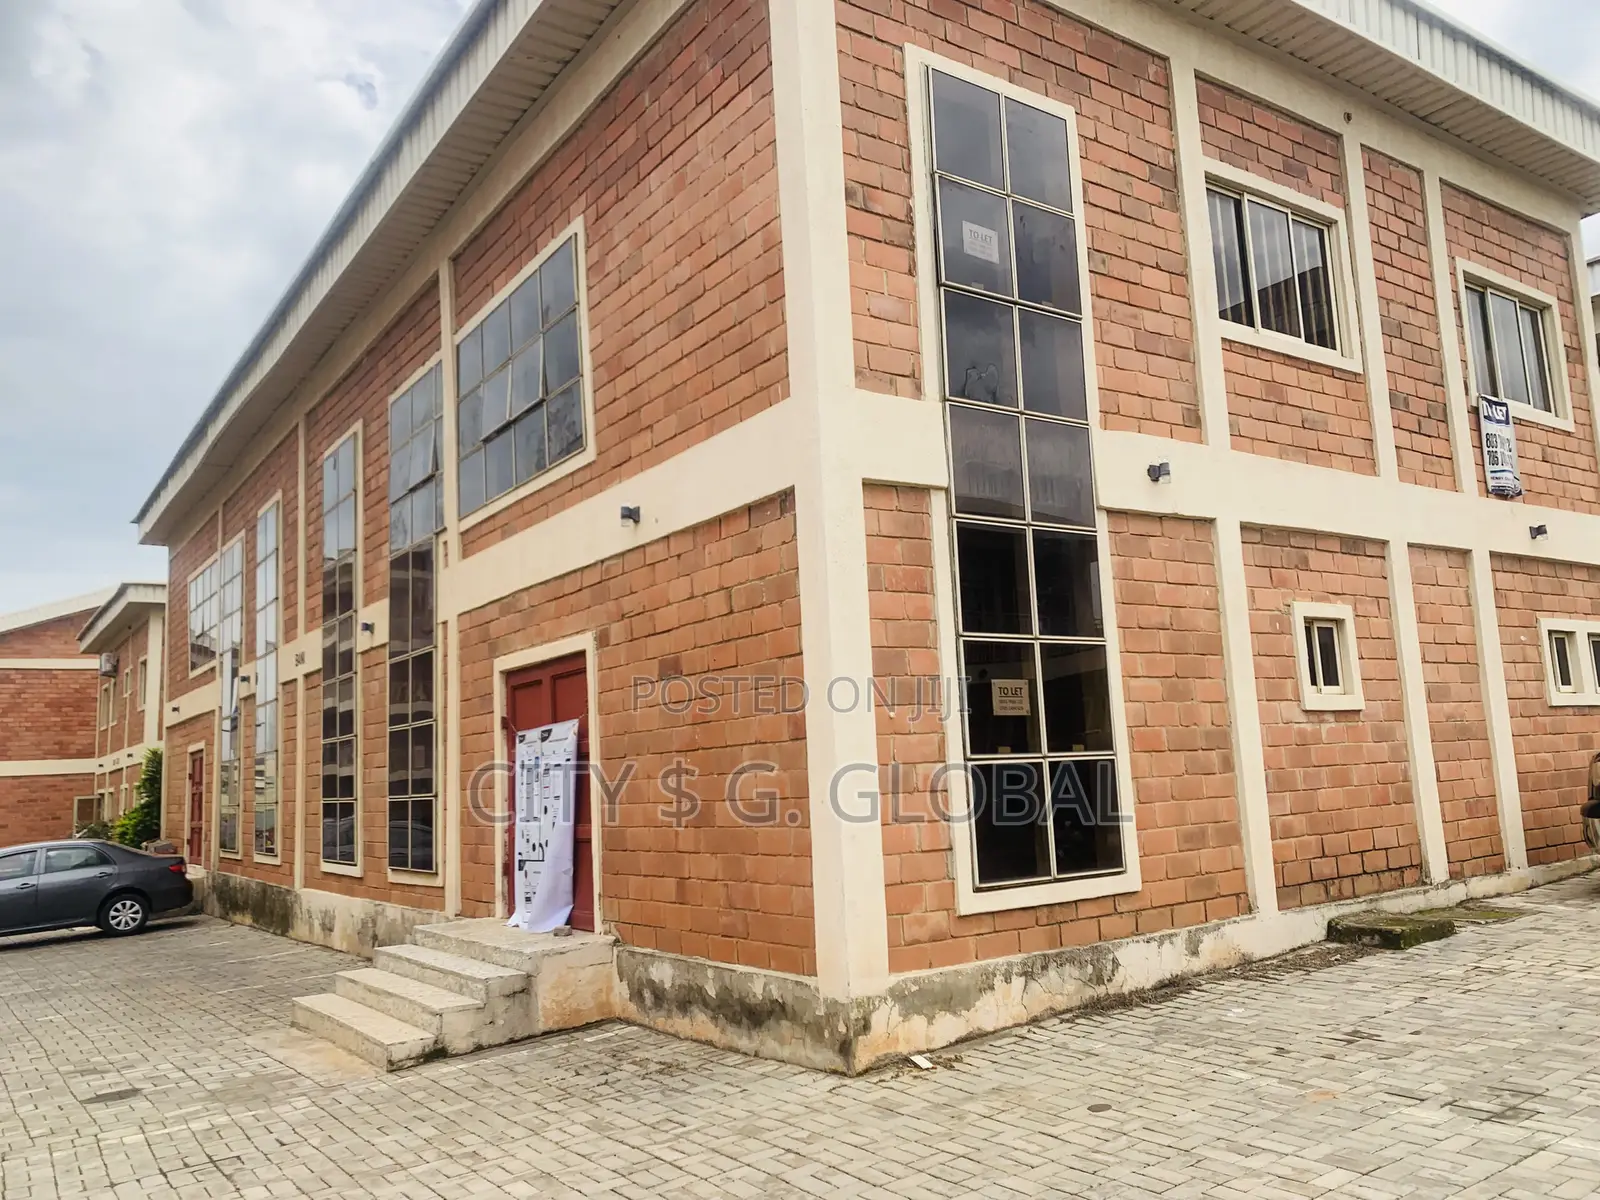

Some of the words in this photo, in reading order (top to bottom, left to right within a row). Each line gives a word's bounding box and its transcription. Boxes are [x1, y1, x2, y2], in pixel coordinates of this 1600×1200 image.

[968, 228, 979, 240] TO
[981, 232, 992, 244] LET
[998, 686, 1009, 695] TO
[1010, 686, 1023, 695] LET
